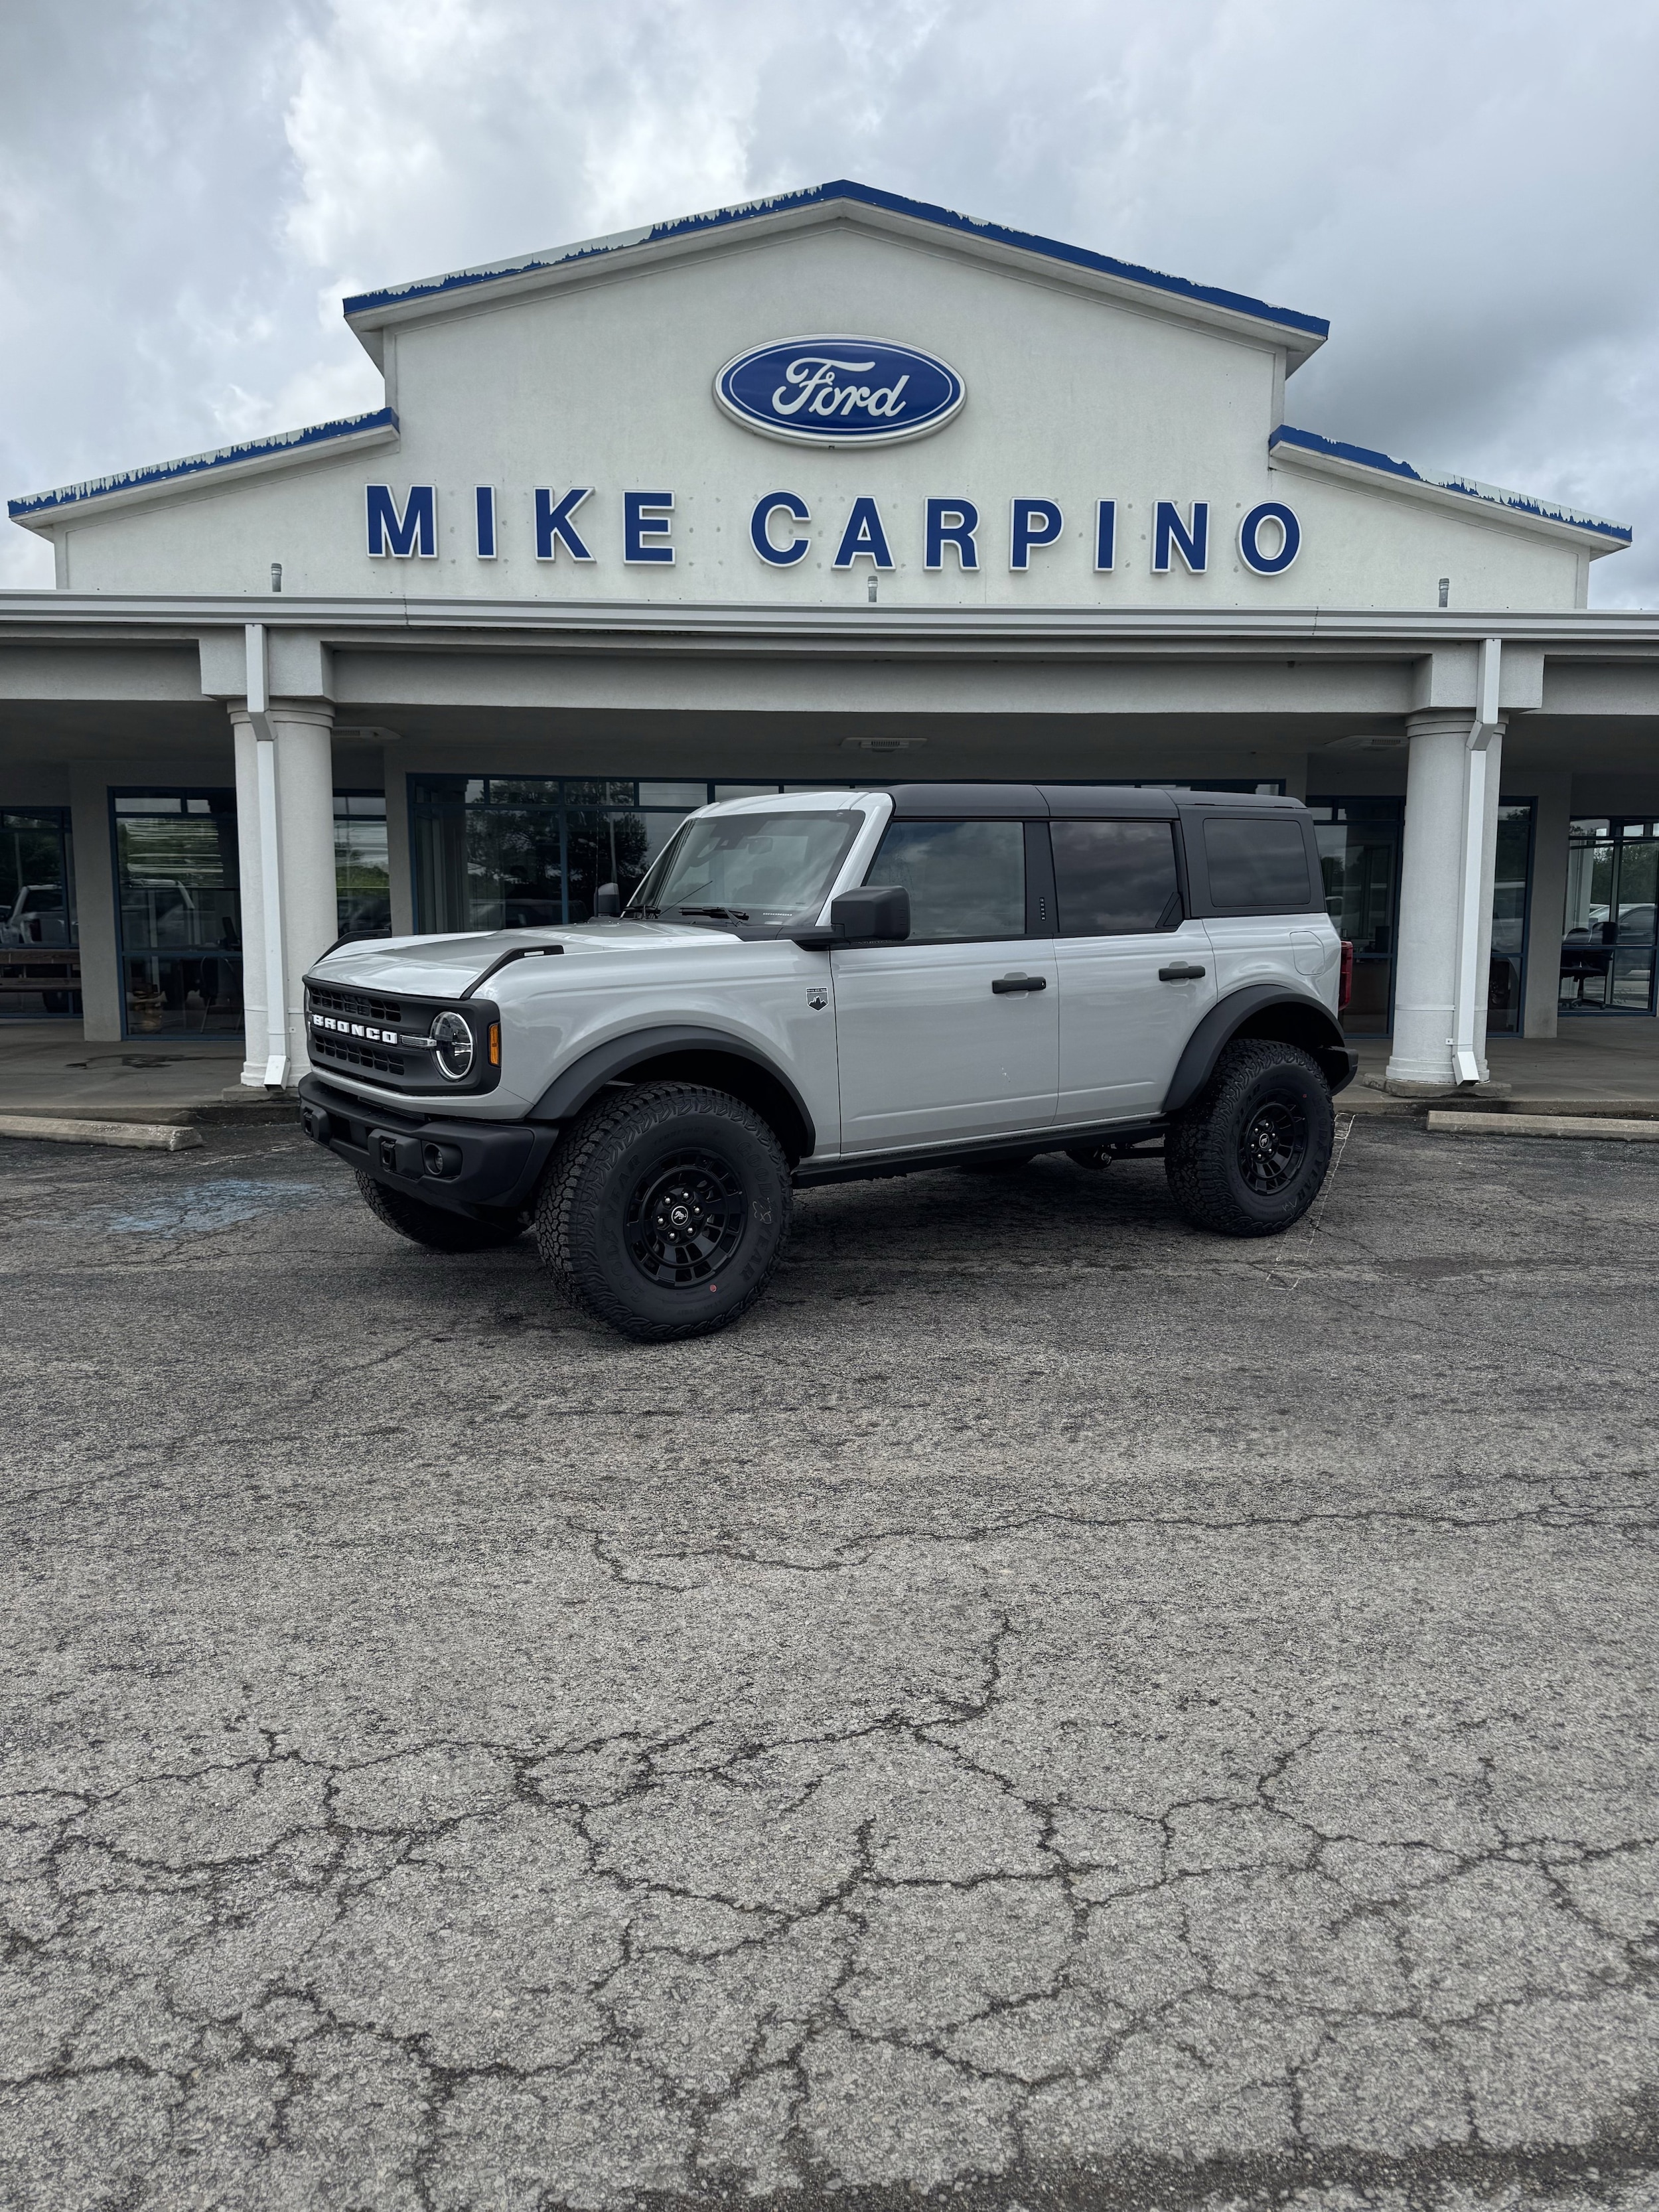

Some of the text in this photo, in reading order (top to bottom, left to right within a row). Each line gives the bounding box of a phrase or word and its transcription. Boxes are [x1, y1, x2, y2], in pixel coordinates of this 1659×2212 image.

[772, 356, 910, 417] Ford
[366, 484, 1301, 573] MIKE CARPINO
[313, 1014, 397, 1044] BRONCO
